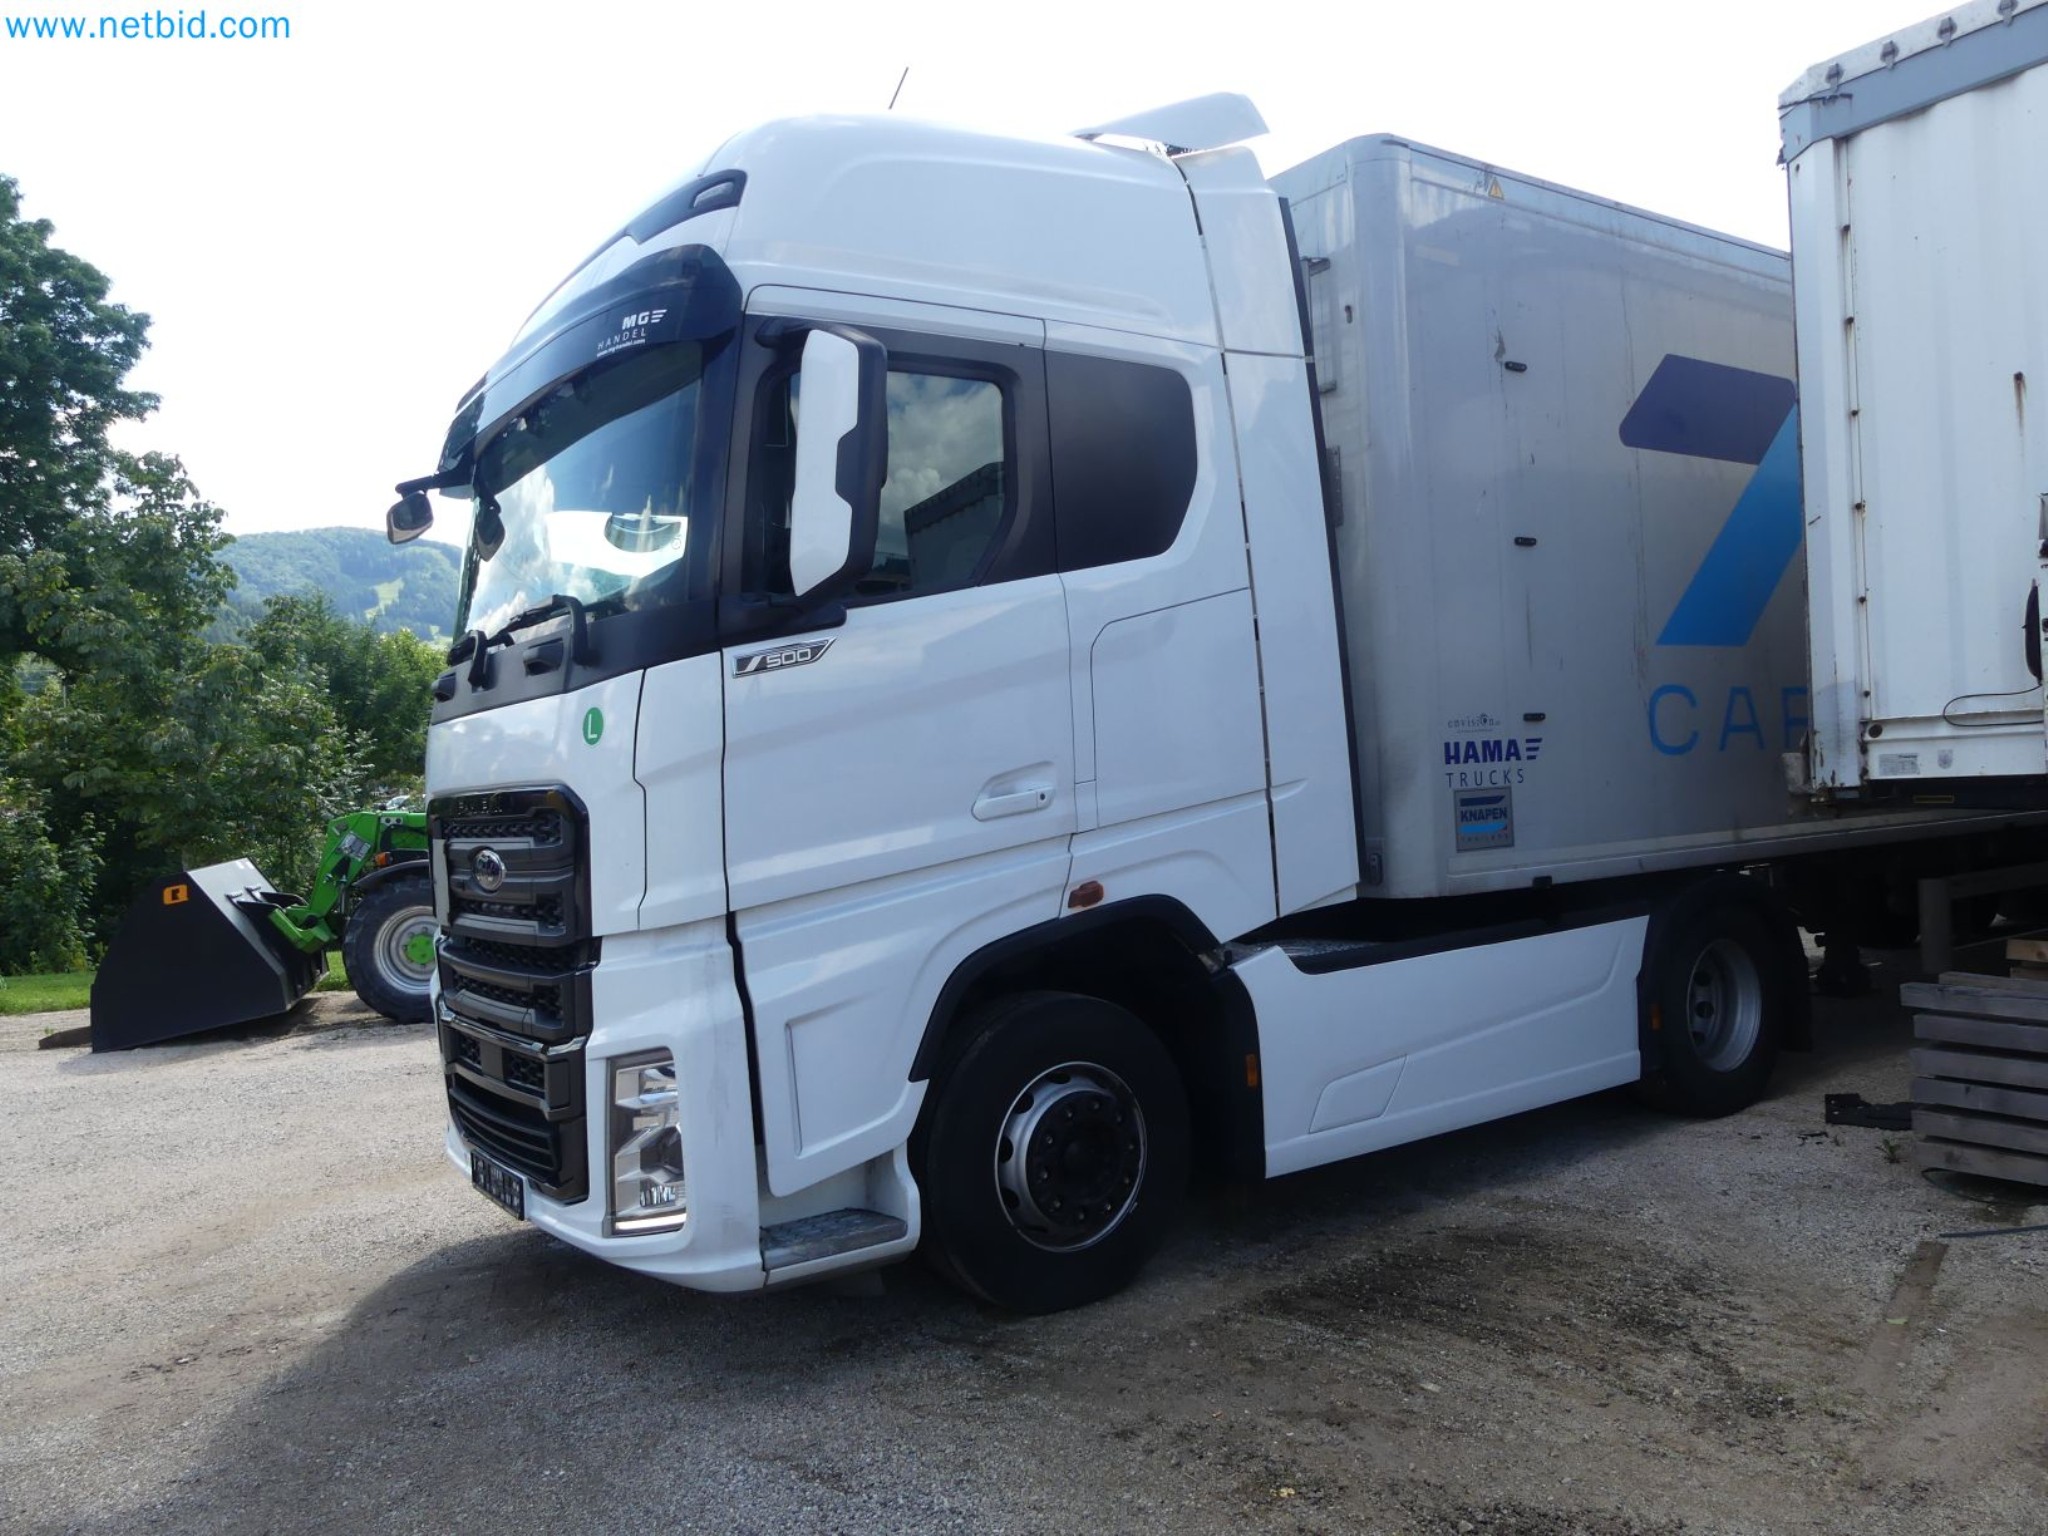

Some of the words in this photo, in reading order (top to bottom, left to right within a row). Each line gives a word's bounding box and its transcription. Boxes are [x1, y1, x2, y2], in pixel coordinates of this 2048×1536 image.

[597, 327, 647, 351] HANDEL
[588, 713, 598, 740] L
[1444, 738, 1522, 765] HAMA
[1445, 768, 1525, 789] TRUCKS
[1460, 807, 1508, 822] KNAPEN
